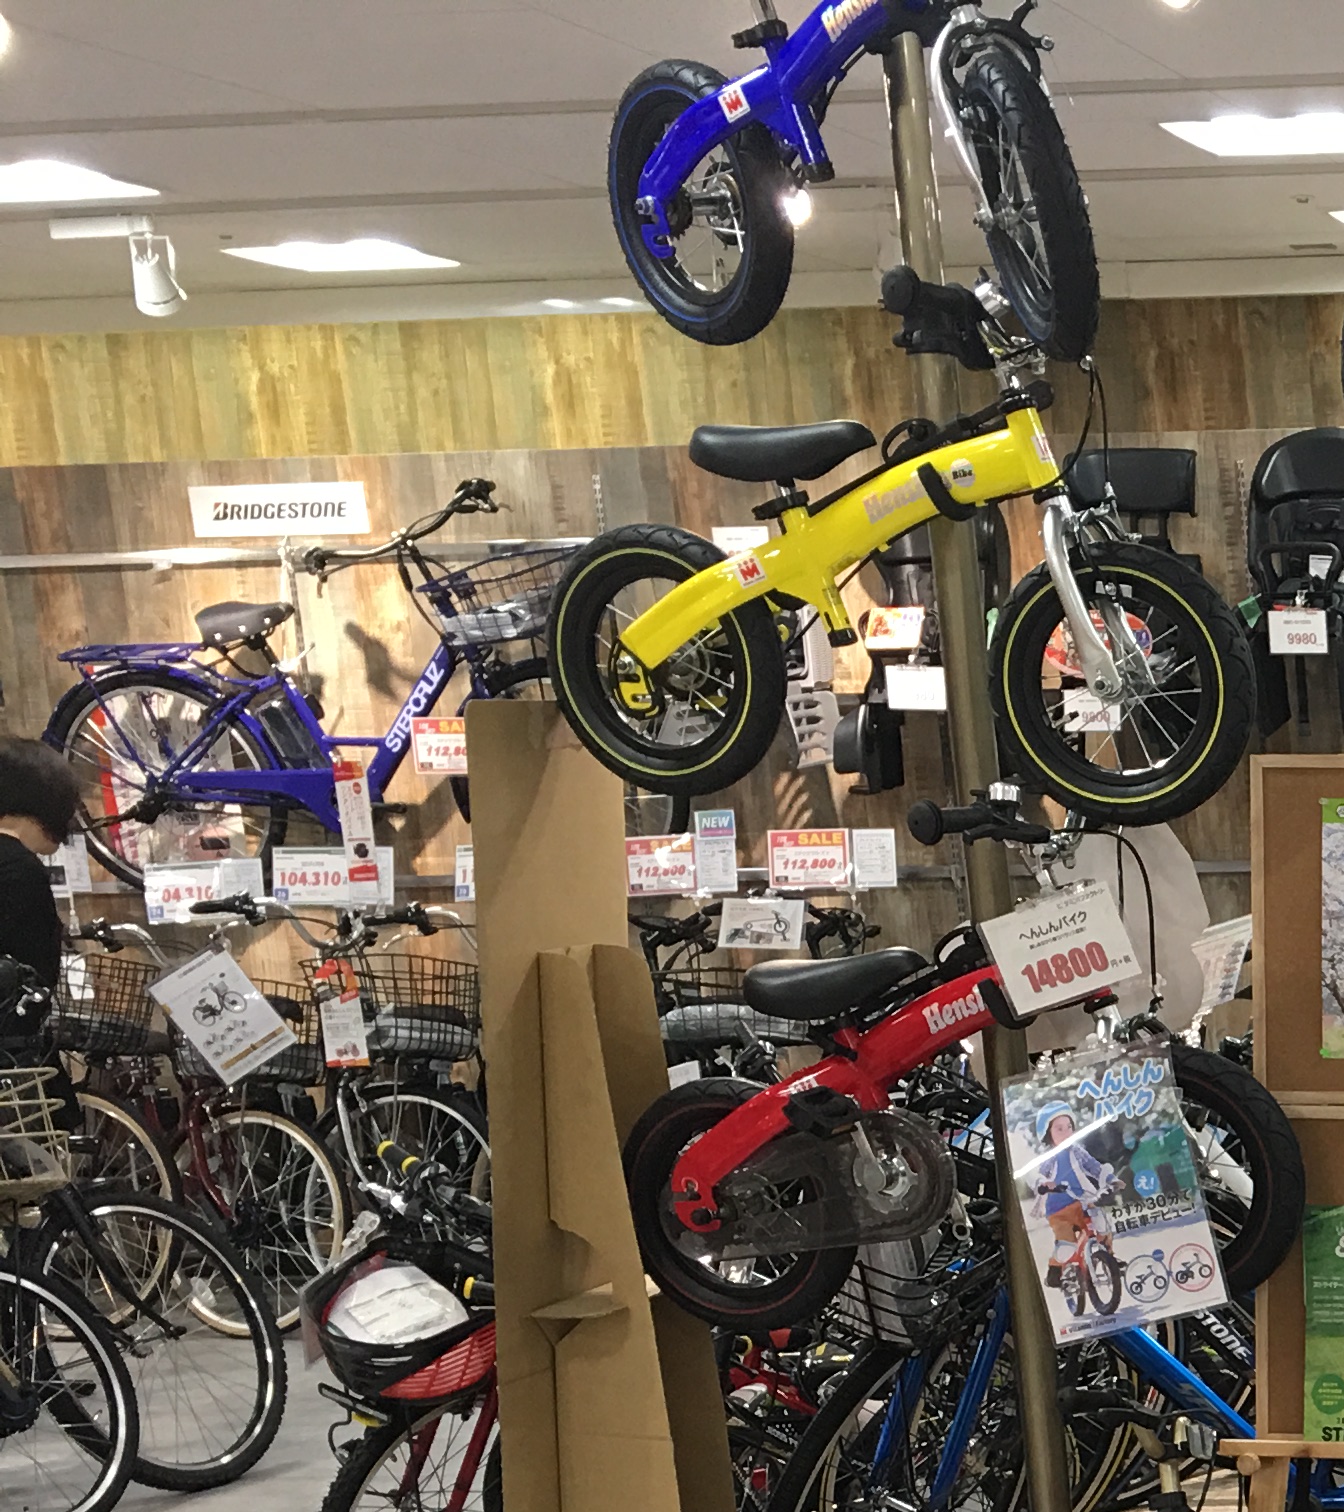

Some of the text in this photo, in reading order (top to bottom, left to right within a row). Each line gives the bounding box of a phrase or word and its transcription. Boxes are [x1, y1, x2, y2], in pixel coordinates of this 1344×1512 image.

[212, 501, 347, 521] BRIDGESTONE
[700, 815, 730, 829] NEW
[798, 832, 843, 846] SALE
[782, 858, 837, 870] 112,800
[1019, 910, 1088, 941] へんしんバイク
[1021, 941, 1110, 993] 14800
[1077, 1059, 1164, 1099] へんしん
[1094, 1087, 1156, 1123] バイク
